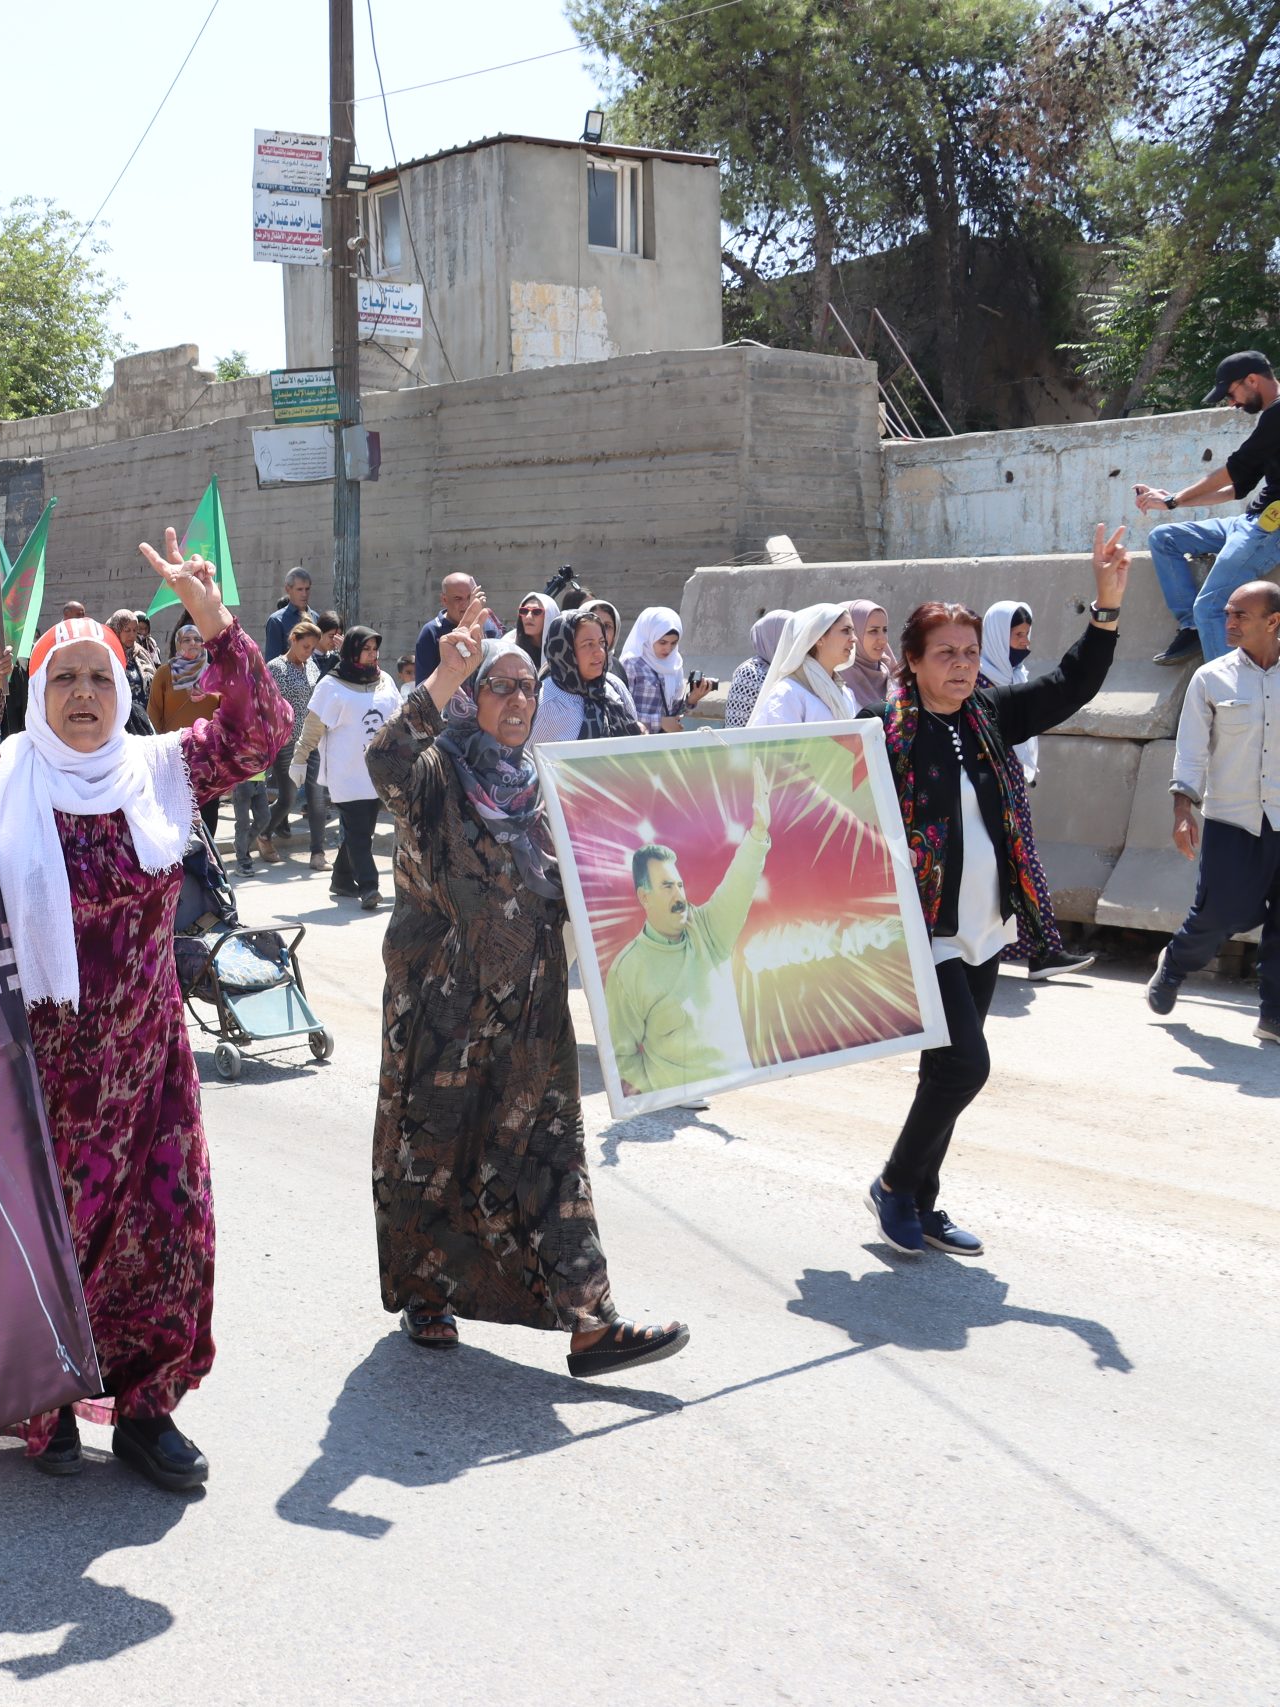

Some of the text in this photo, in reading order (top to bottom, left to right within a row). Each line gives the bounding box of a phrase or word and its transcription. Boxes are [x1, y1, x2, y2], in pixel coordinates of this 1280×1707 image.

[272, 198, 300, 208] الدكتور
[392, 298, 418, 314] رحاب
[55, 618, 105, 644] APO
